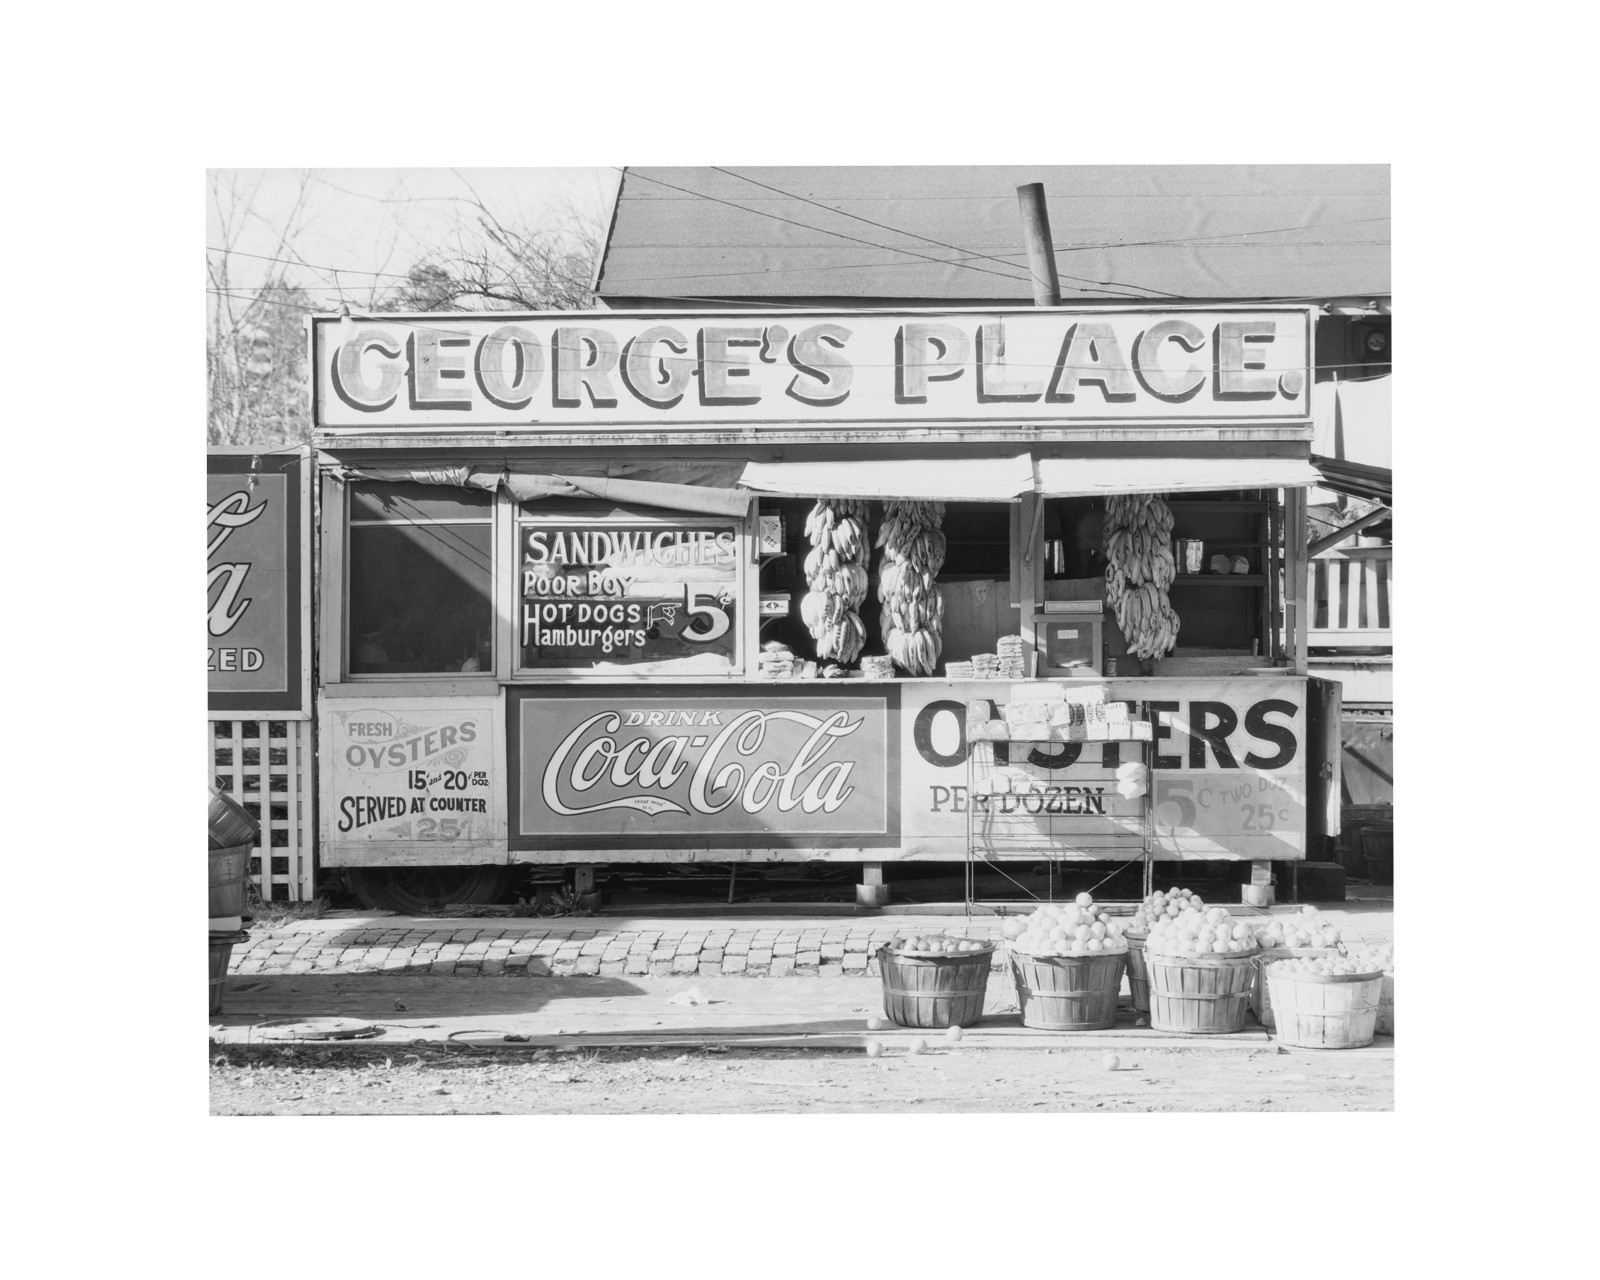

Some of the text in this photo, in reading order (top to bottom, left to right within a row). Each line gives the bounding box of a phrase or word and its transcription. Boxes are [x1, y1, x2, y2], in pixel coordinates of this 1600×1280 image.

[331, 319, 1304, 412] GEORGE'S PLACE.
[525, 530, 736, 567] SANDWICHES
[523, 570, 635, 598] POOR BOY
[523, 603, 641, 633] HOT DOGS
[523, 615, 646, 653] Hamburgers
[348, 722, 393, 737] FRESH
[623, 710, 723, 727] DRINK
[345, 721, 477, 769] OYSTERS
[473, 771, 487, 779] PER
[541, 709, 866, 817] Coca-Cola
[1219, 782, 1252, 805] TWO
[337, 795, 488, 833] SERVED AT COUNTER
